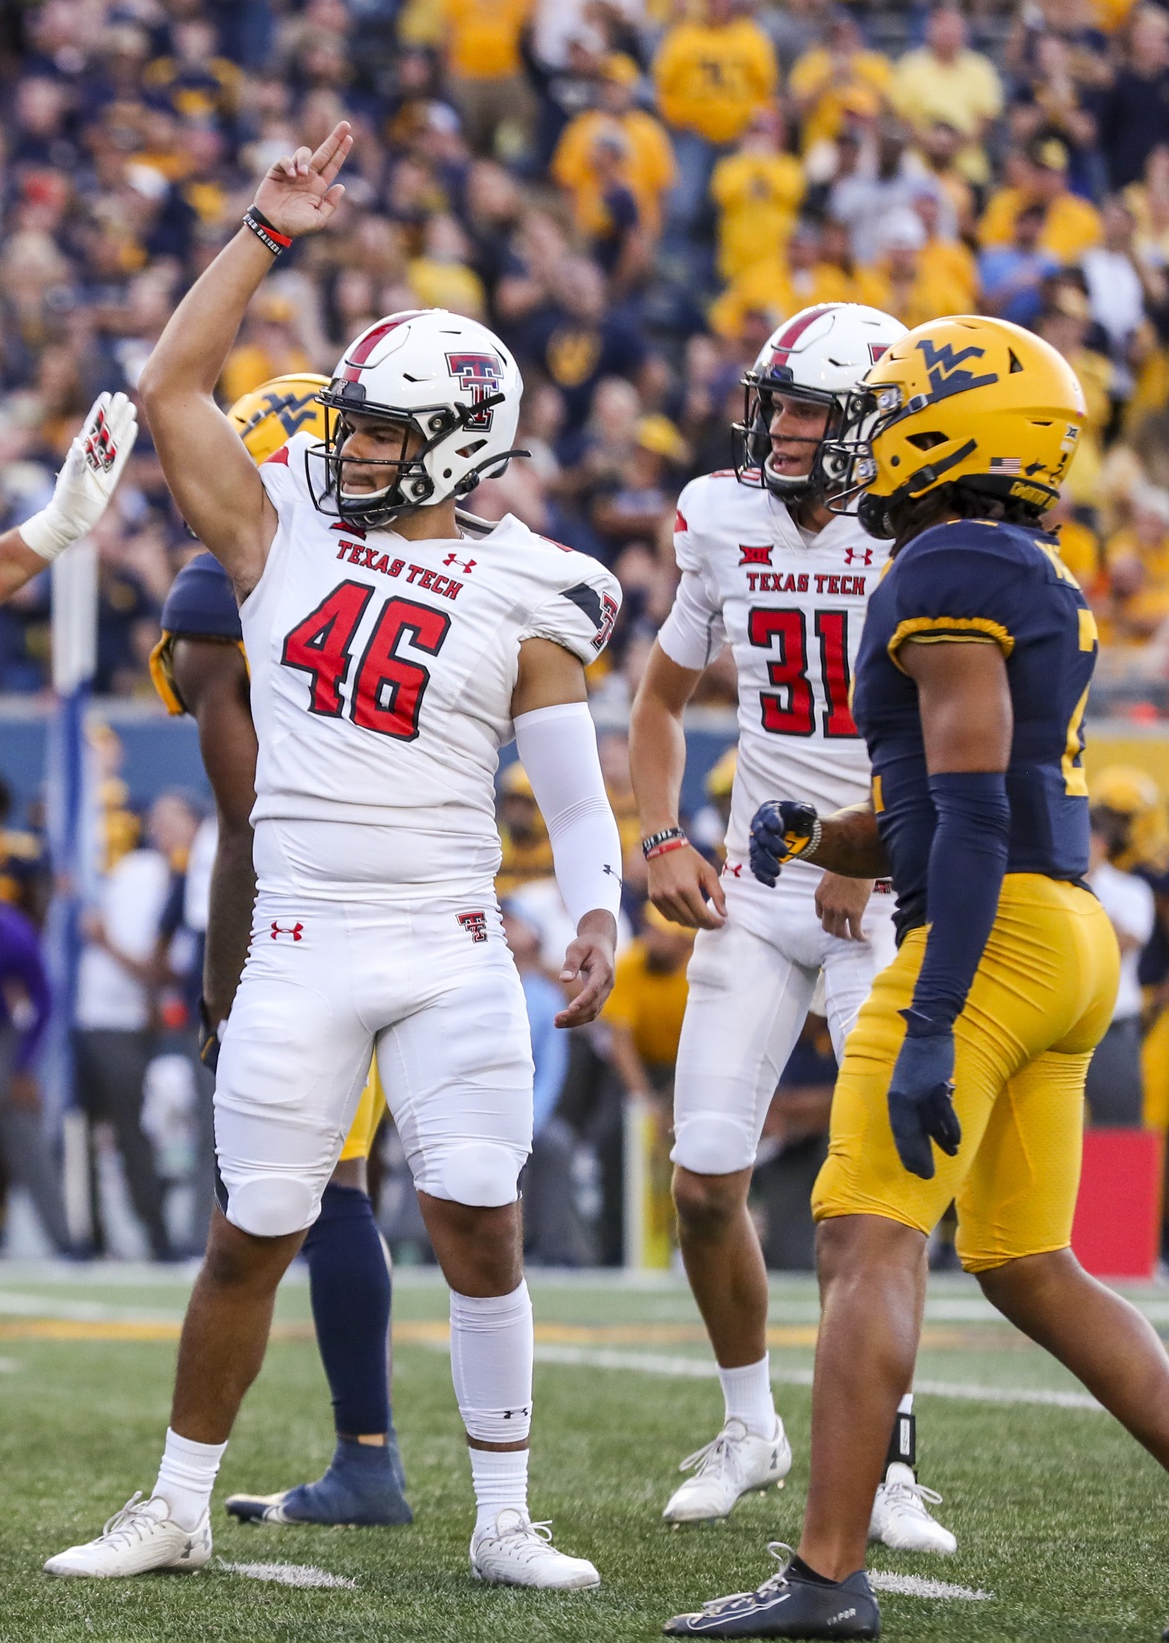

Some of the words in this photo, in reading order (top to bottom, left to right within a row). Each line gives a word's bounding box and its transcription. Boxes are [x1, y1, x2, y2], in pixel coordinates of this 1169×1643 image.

[336, 540, 405, 577] TEXAS
[405, 564, 464, 601] TECH
[746, 572, 810, 593] TEXAS
[813, 574, 867, 596] TECH
[280, 578, 452, 743] 46
[747, 606, 867, 740] 31
